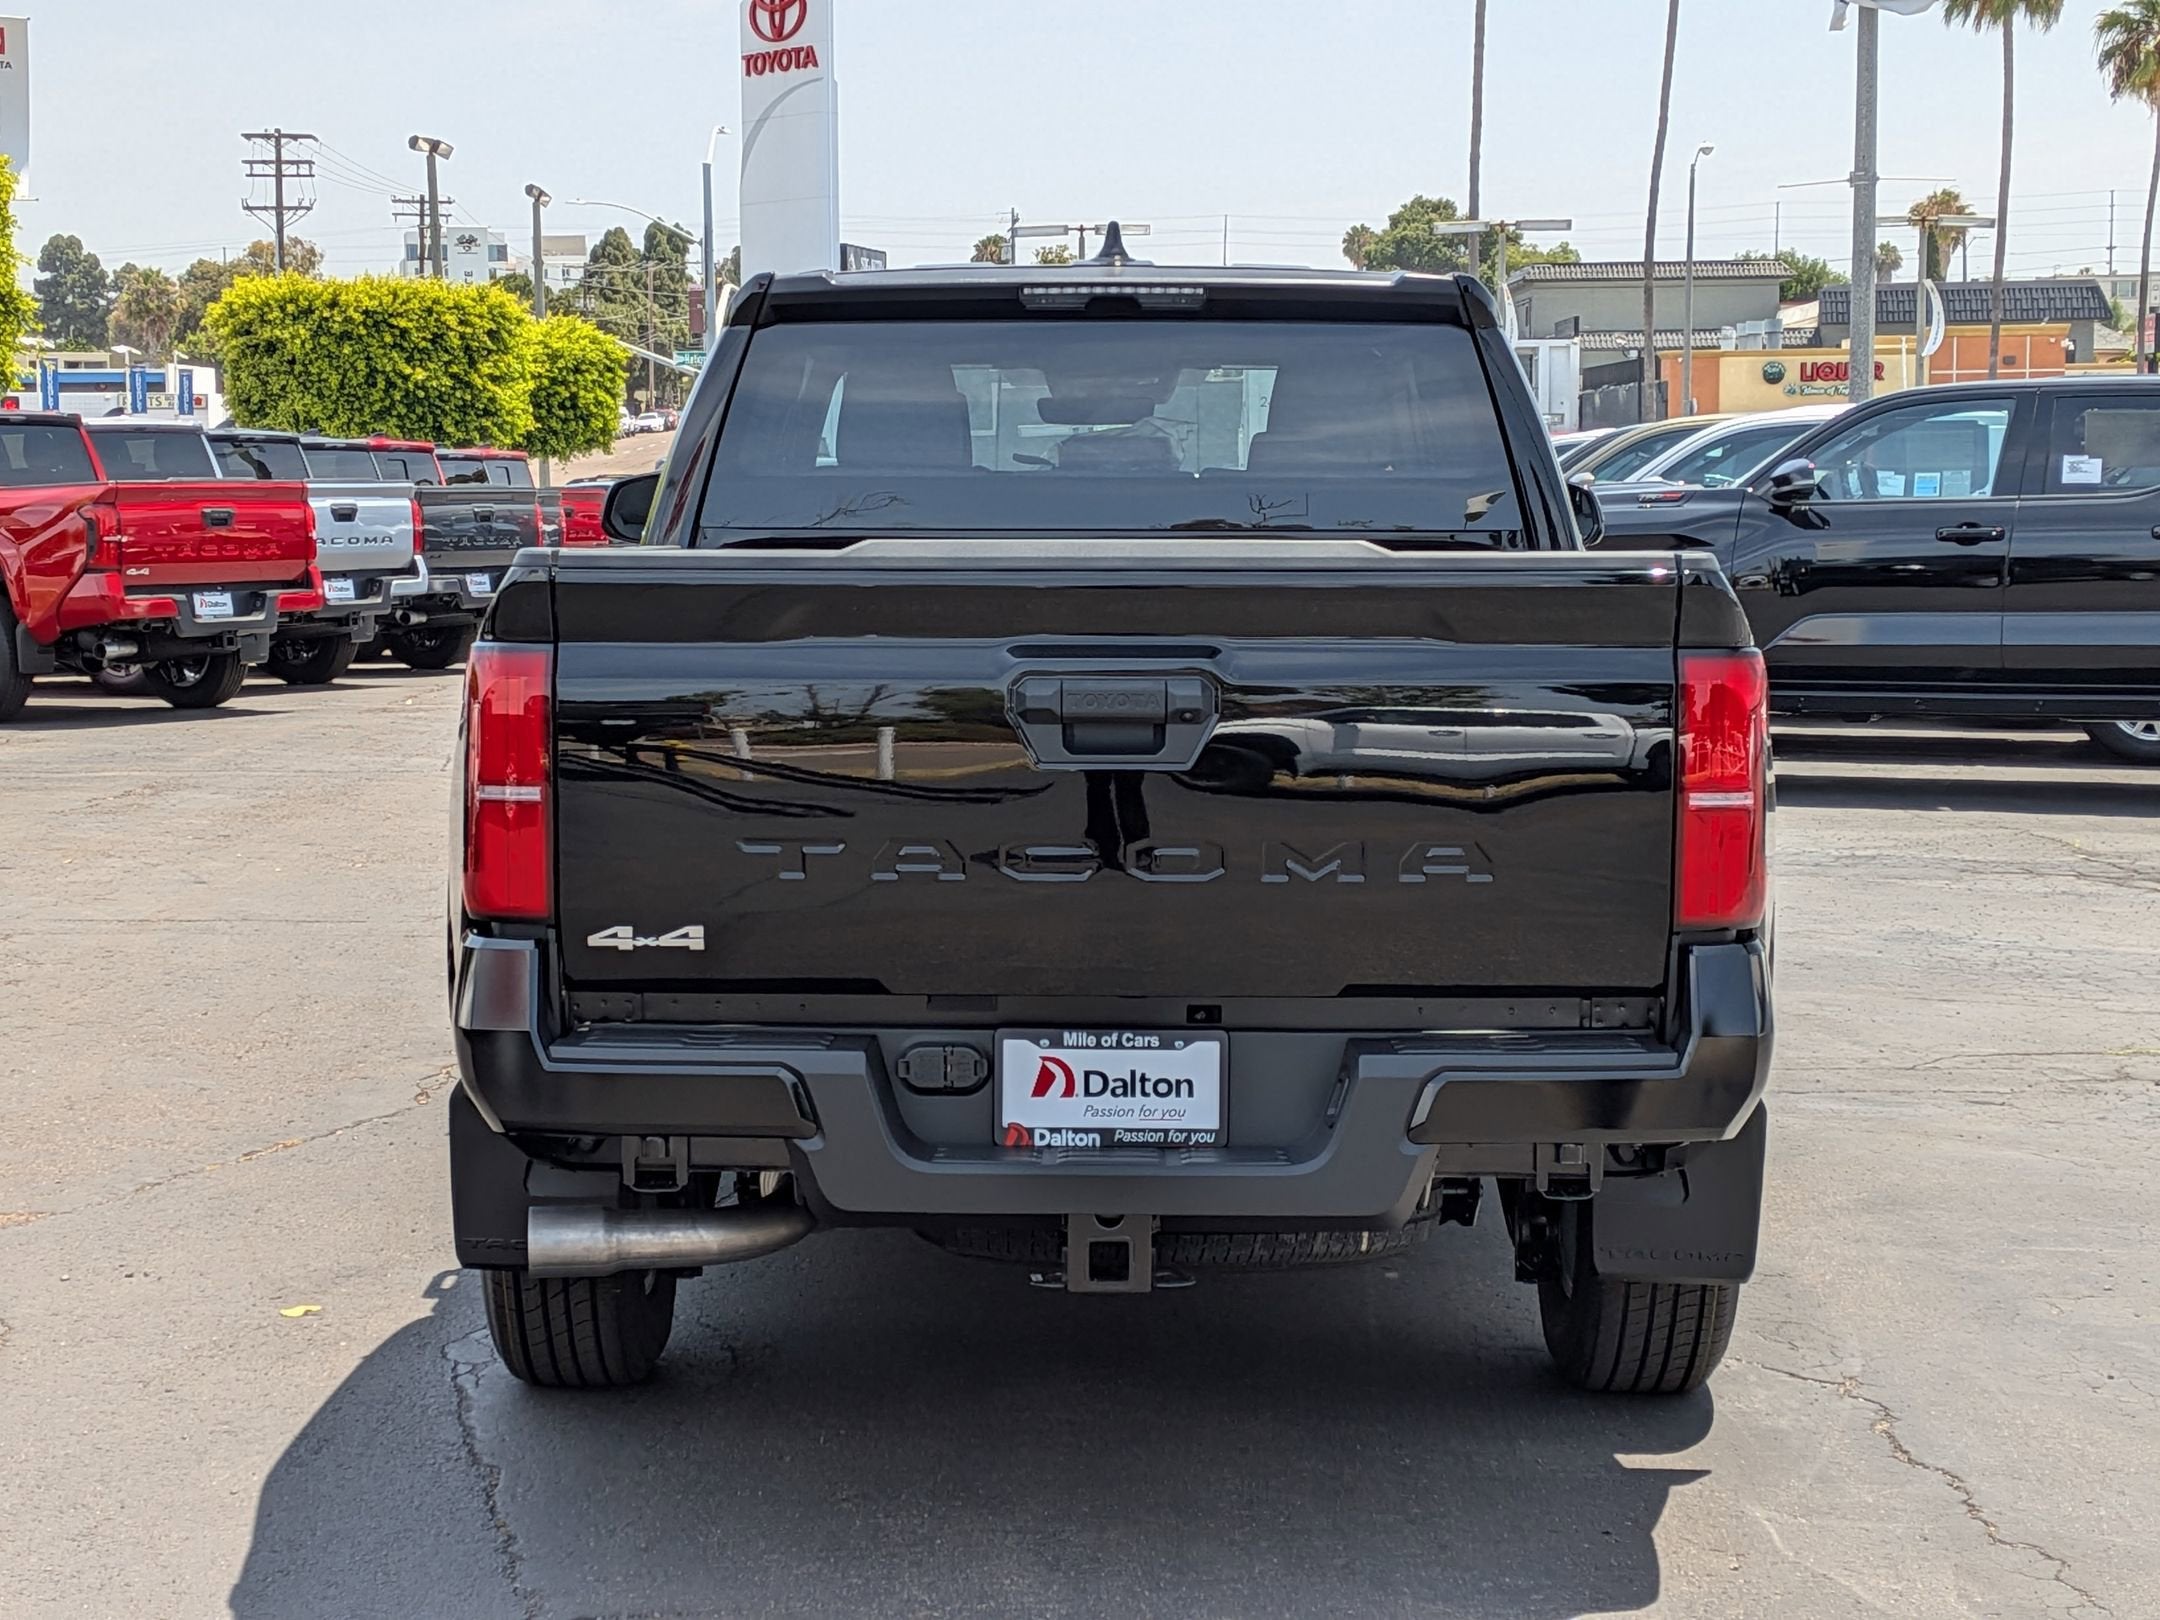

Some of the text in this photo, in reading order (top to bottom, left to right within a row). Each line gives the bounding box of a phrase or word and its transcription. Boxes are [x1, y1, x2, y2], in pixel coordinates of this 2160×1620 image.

[741, 45, 819, 77] TOYOTA
[1800, 361, 1885, 382] LIQUR
[315, 535, 394, 546] ACOMA
[1066, 692, 1161, 709] TOYOTA
[736, 838, 1495, 883] TACOMA
[587, 925, 705, 951] 4x4
[1063, 1032, 1160, 1048] Mile of Cars
[1083, 1069, 1194, 1098] Dalton
[1083, 1105, 1186, 1120] Passion for you
[1034, 1129, 1100, 1147] Dalton
[1114, 1129, 1216, 1145] Passion for you
